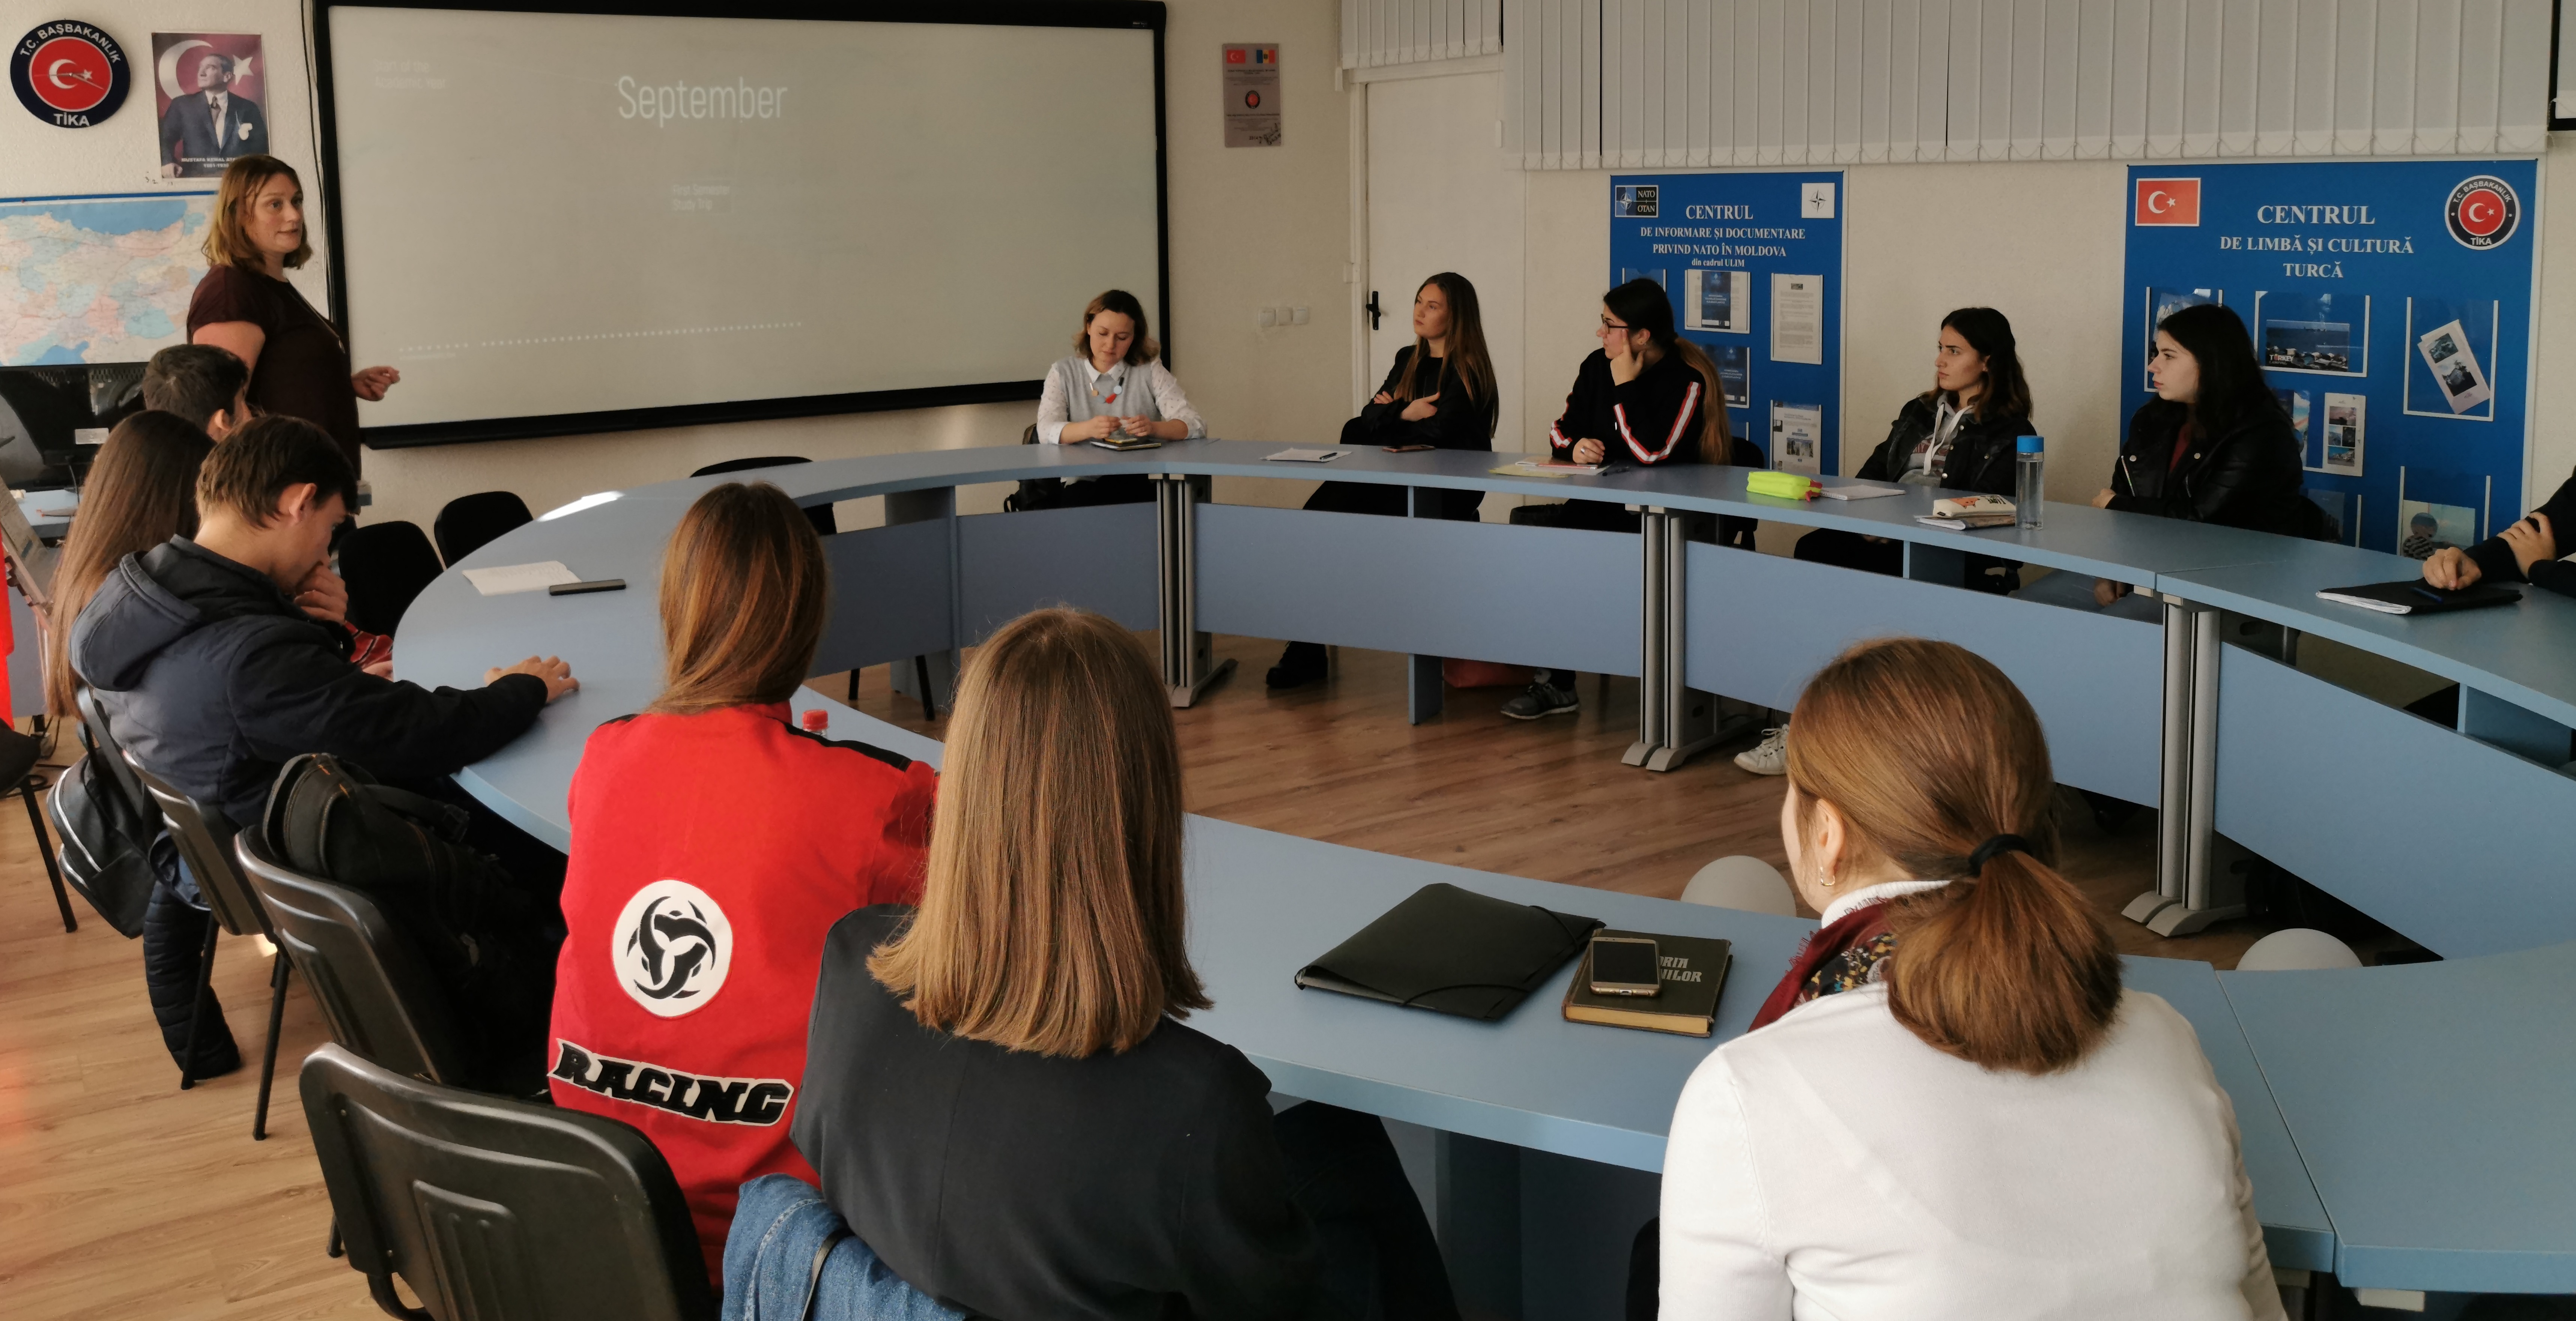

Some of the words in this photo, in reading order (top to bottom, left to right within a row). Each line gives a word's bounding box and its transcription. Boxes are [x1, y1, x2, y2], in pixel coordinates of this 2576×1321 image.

[20, 39, 39, 56] T.C.
[37, 24, 121, 63] BAŞBAKANLIK
[618, 75, 788, 128] September
[53, 112, 90, 126] TİKA
[2463, 181, 2512, 203] BAŞBAKANLIK
[1686, 205, 1753, 220] CENTRUL
[2257, 205, 2375, 225] CENTRUL
[1641, 227, 1653, 237] DE
[1655, 227, 1712, 238] INFORMARE
[1726, 228, 1806, 239] DOCUMENTARE
[2470, 237, 2492, 245] TİKA
[1653, 244, 1691, 254] PRIVIND
[1693, 245, 1719, 255] NATO
[1722, 242, 1732, 255] ÎN
[1735, 245, 1787, 257] MOLDOVA
[2220, 236, 2242, 250] DE
[2247, 234, 2303, 251] LIMBĂ
[2328, 236, 2414, 254] CULTURĂ
[2283, 261, 2344, 278] TURCĂ
[549, 1040, 792, 1125] RACING
